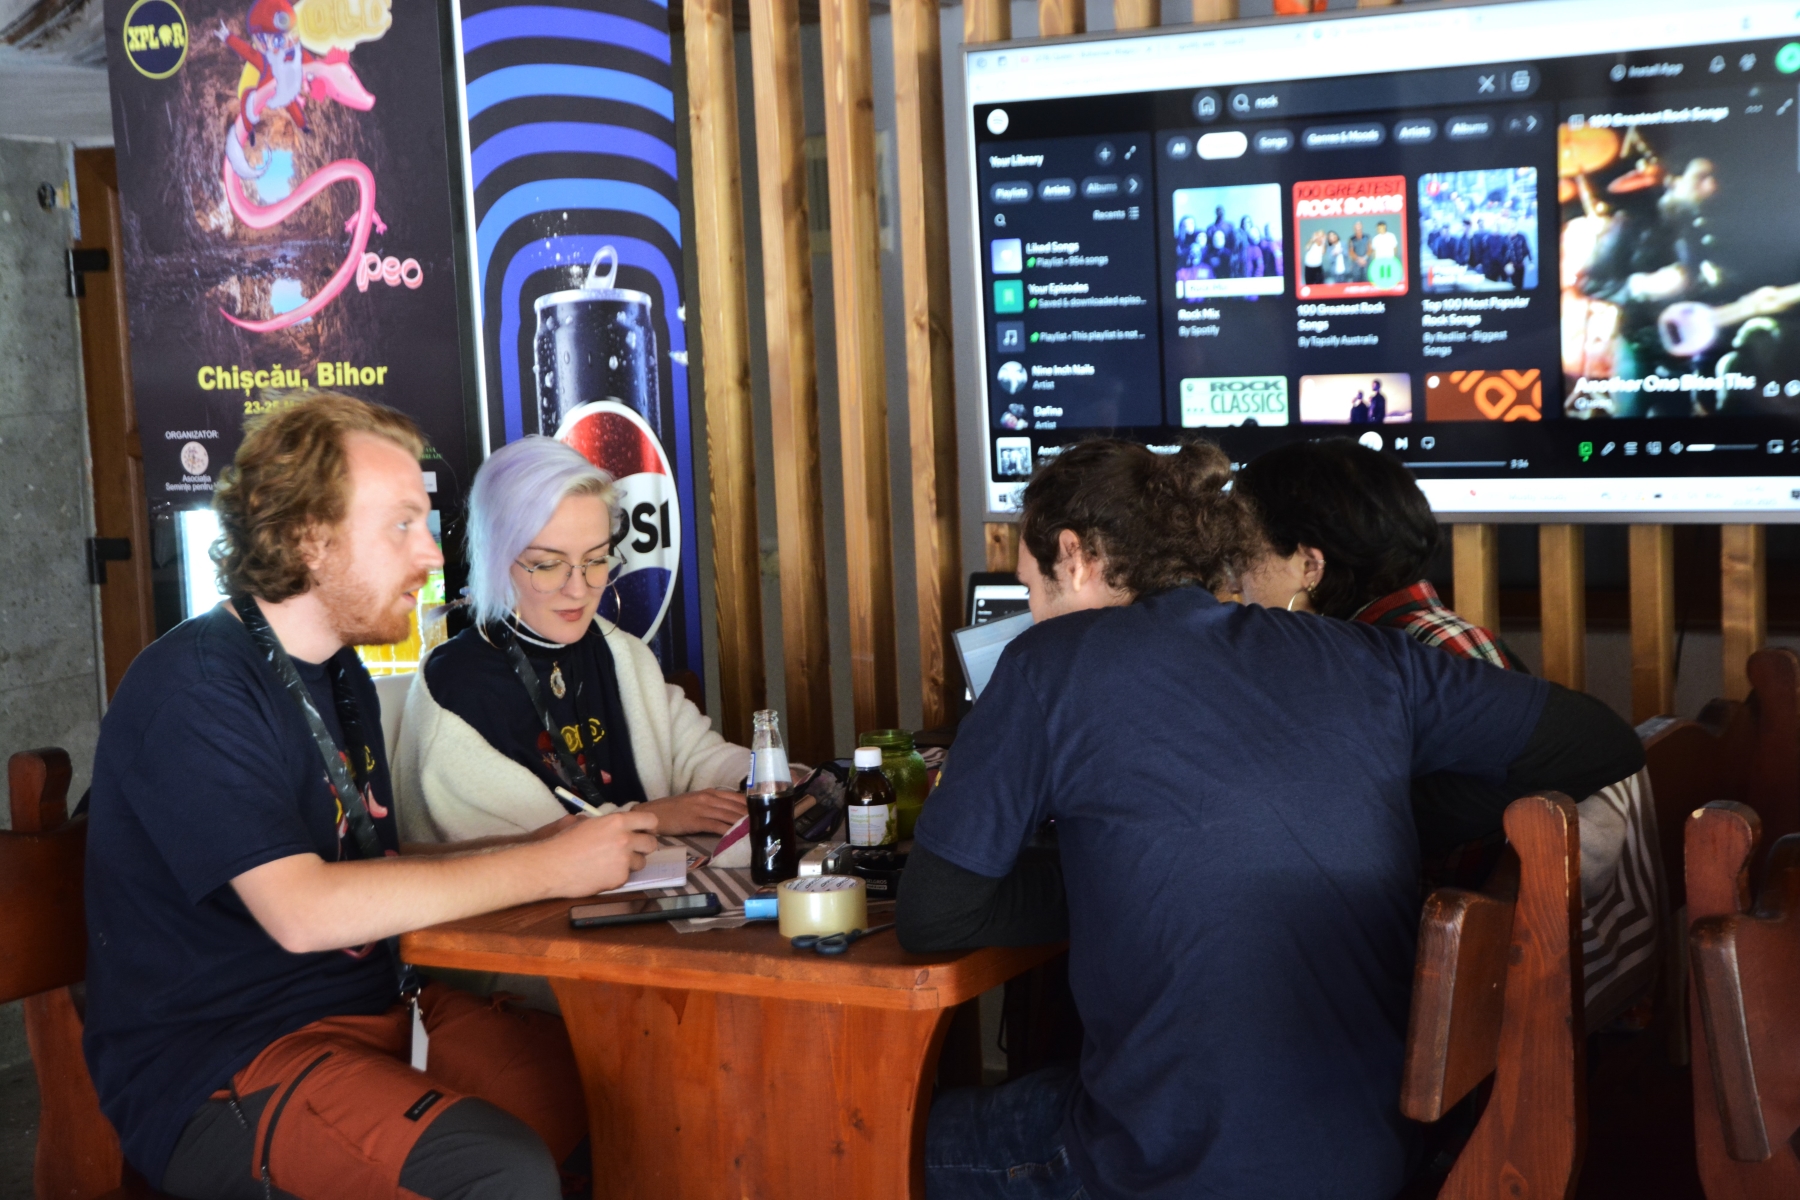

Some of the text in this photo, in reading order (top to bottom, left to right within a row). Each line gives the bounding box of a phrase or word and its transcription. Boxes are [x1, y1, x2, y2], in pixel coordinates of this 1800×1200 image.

[1662, 108, 1691, 124] Rock
[1399, 126, 1431, 139] Artists
[1451, 122, 1488, 136] Albums
[989, 154, 1044, 168] Your Library
[995, 186, 1028, 199] Playlists
[1043, 184, 1070, 196] Artists
[1086, 182, 1117, 194] Albums
[1297, 180, 1401, 198] 100 GREATEST
[1296, 194, 1403, 217] ROCK SONGS
[1093, 209, 1125, 221] Recents
[1026, 241, 1079, 255] Liked Songs
[1036, 256, 1063, 269] Playlist
[1085, 256, 1109, 267] songs
[1027, 282, 1089, 296] Your Episodes
[1038, 298, 1062, 309] Saved
[1297, 301, 1386, 316] 100 Greatest Rock
[1421, 296, 1530, 313] Top 100 Most Popular
[1178, 308, 1220, 321] Rock Mix
[1422, 313, 1482, 328] Rock Songs
[1179, 325, 1220, 338] By Spotify
[1297, 319, 1329, 333] Songs
[1040, 331, 1067, 343] Playlist
[1298, 336, 1310, 349] By
[1422, 332, 1434, 345] By
[1423, 345, 1452, 358] Songs
[317, 361, 388, 387] Bihor
[1032, 380, 1055, 390] Artist
[1210, 380, 1282, 391] ROCK
[1574, 372, 1757, 393] Another One Bites The
[1211, 392, 1285, 413] CLASSICS
[1034, 421, 1057, 430] Artist
[165, 430, 219, 440] ORGANIZATOR:
[609, 499, 671, 557] PSI
